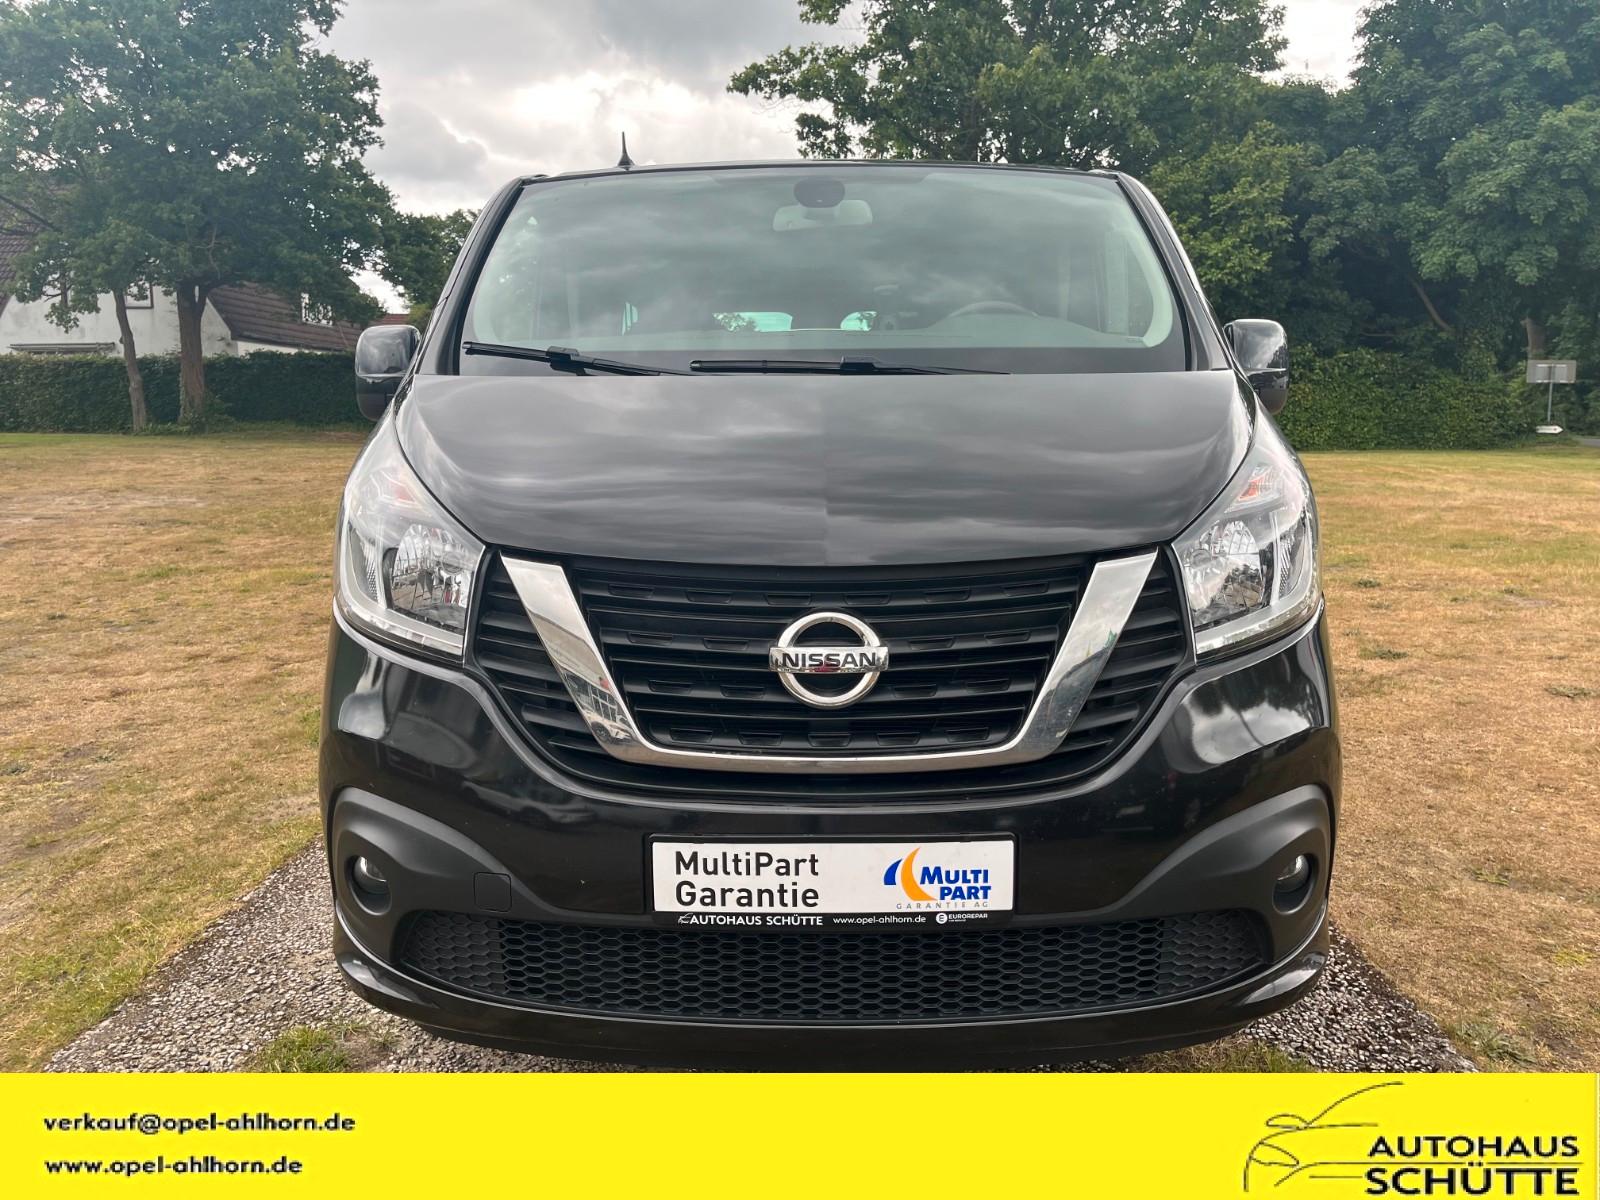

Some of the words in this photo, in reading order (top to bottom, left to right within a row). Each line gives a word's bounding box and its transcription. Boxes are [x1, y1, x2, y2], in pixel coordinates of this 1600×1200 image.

[782, 652, 876, 668] NISSAN
[675, 850, 819, 877] MultiPart
[675, 880, 819, 908] Garantie
[939, 885, 992, 901] PART
[896, 902, 966, 910] GARANTIE
[689, 916, 762, 926] AUTOHAUS
[766, 913, 823, 926] SCHÜTTE
[832, 914, 927, 926] www.opel-ahlhorn.de
